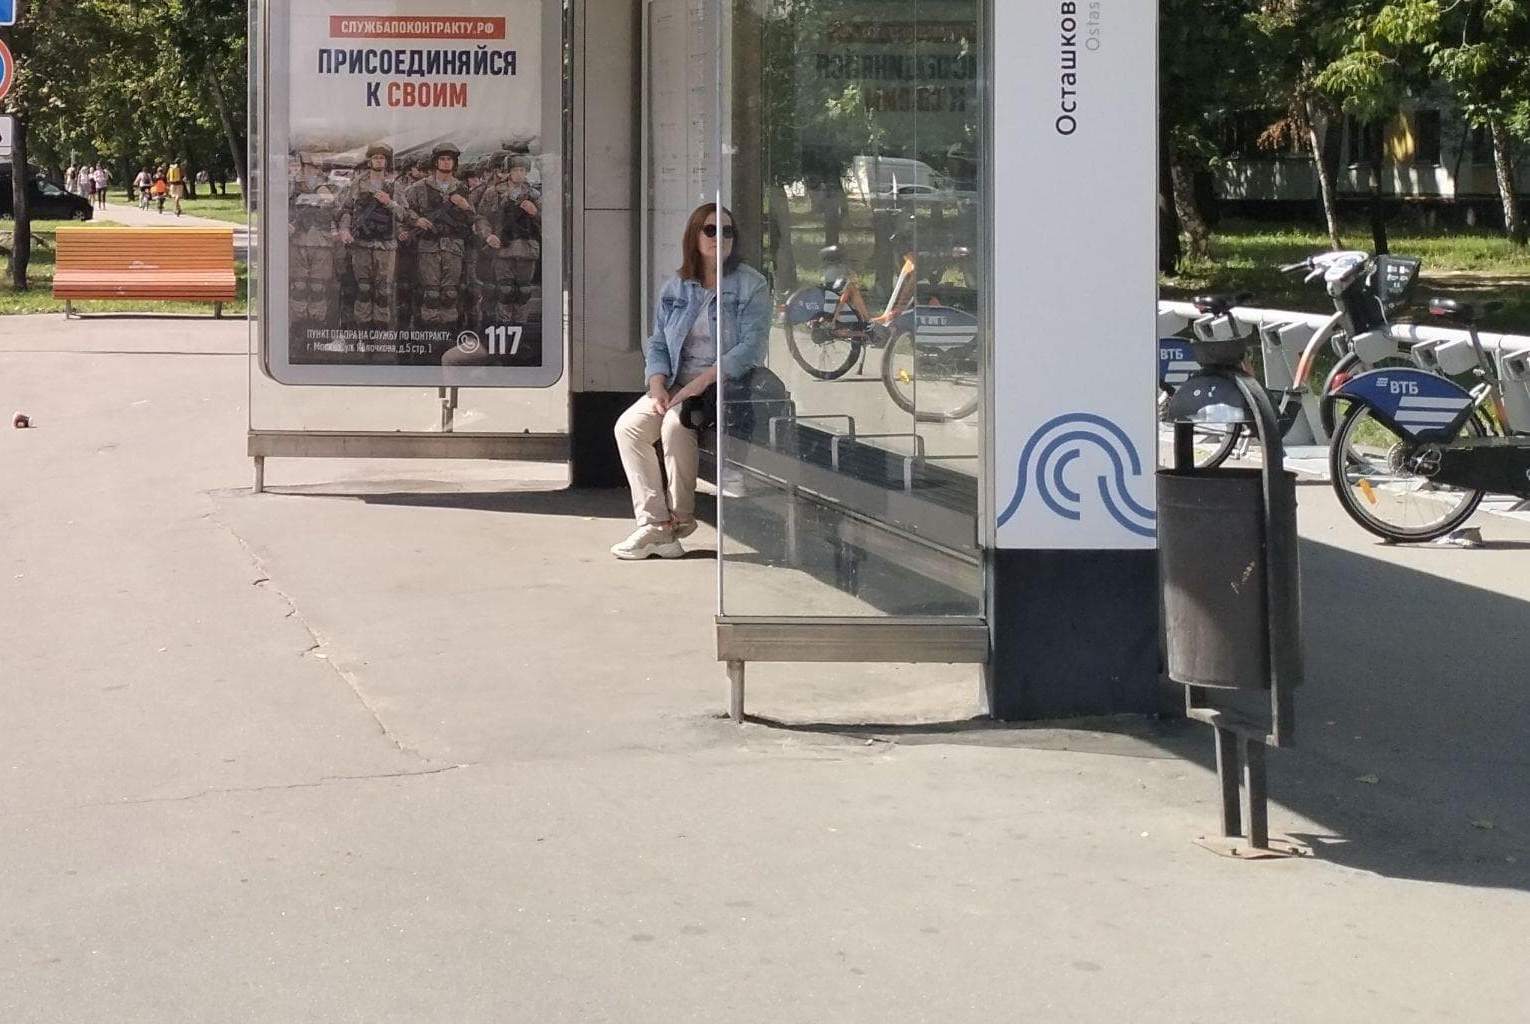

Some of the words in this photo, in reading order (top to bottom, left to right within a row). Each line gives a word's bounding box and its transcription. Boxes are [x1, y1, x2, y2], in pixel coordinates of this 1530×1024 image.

[341, 21, 495, 35] СЛУЖБАПОКОНТРАКТУ.РФ
[318, 44, 517, 77] ПРИСОЕДИНЯЙСЯ
[367, 82, 381, 107] К
[387, 82, 468, 108] СВОИМ
[306, 329, 330, 339] ПУНКТ
[369, 330, 398, 341] СЛУЖБУ
[399, 330, 410, 341] ПО
[485, 326, 523, 355] 117
[1160, 348, 1184, 360] ВТБ
[1390, 379, 1419, 395] ВТБ
